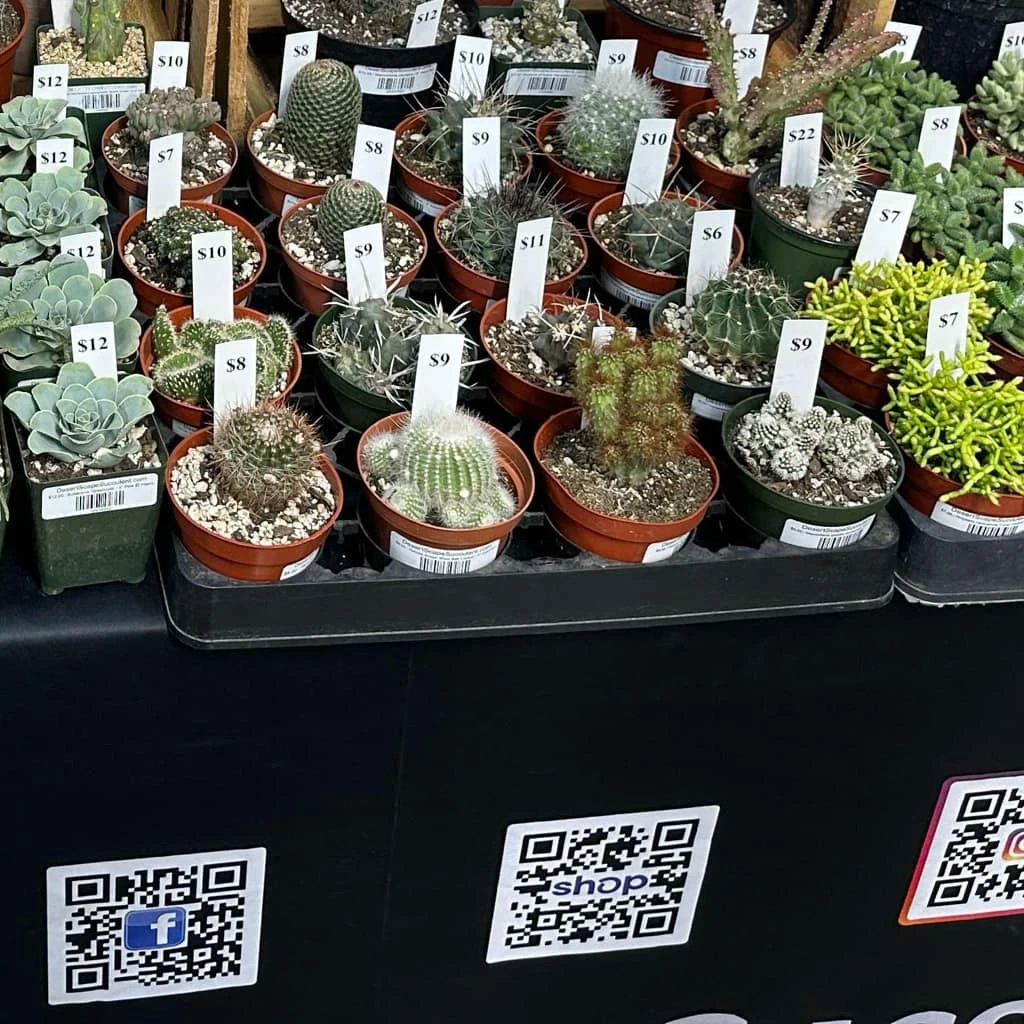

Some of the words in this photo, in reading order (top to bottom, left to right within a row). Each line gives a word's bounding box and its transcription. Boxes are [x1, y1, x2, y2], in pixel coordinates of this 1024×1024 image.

[416, 8, 439, 24] $12
[292, 44, 310, 58] $8
[459, 51, 485, 65] $10
[607, 51, 626, 65] $9
[739, 47, 757, 60] $8
[157, 55, 184, 68] $10
[37, 75, 63, 88] $12
[931, 117, 950, 132] $8
[471, 132, 490, 145] $9
[640, 132, 668, 146] $10
[788, 128, 816, 142] $22
[364, 140, 384, 155] $8
[40, 151, 68, 164] $12
[157, 148, 174, 163] $7
[879, 208, 902, 224] $7
[701, 226, 722, 241] $6
[519, 233, 546, 250] $11
[196, 245, 227, 261] $10
[354, 243, 373, 259] $9
[938, 312, 960, 329] $7
[77, 336, 109, 353] $12
[789, 336, 813, 353] $9
[225, 356, 247, 372] $8
[429, 352, 451, 368] $9
[551, 873, 649, 897] shop
